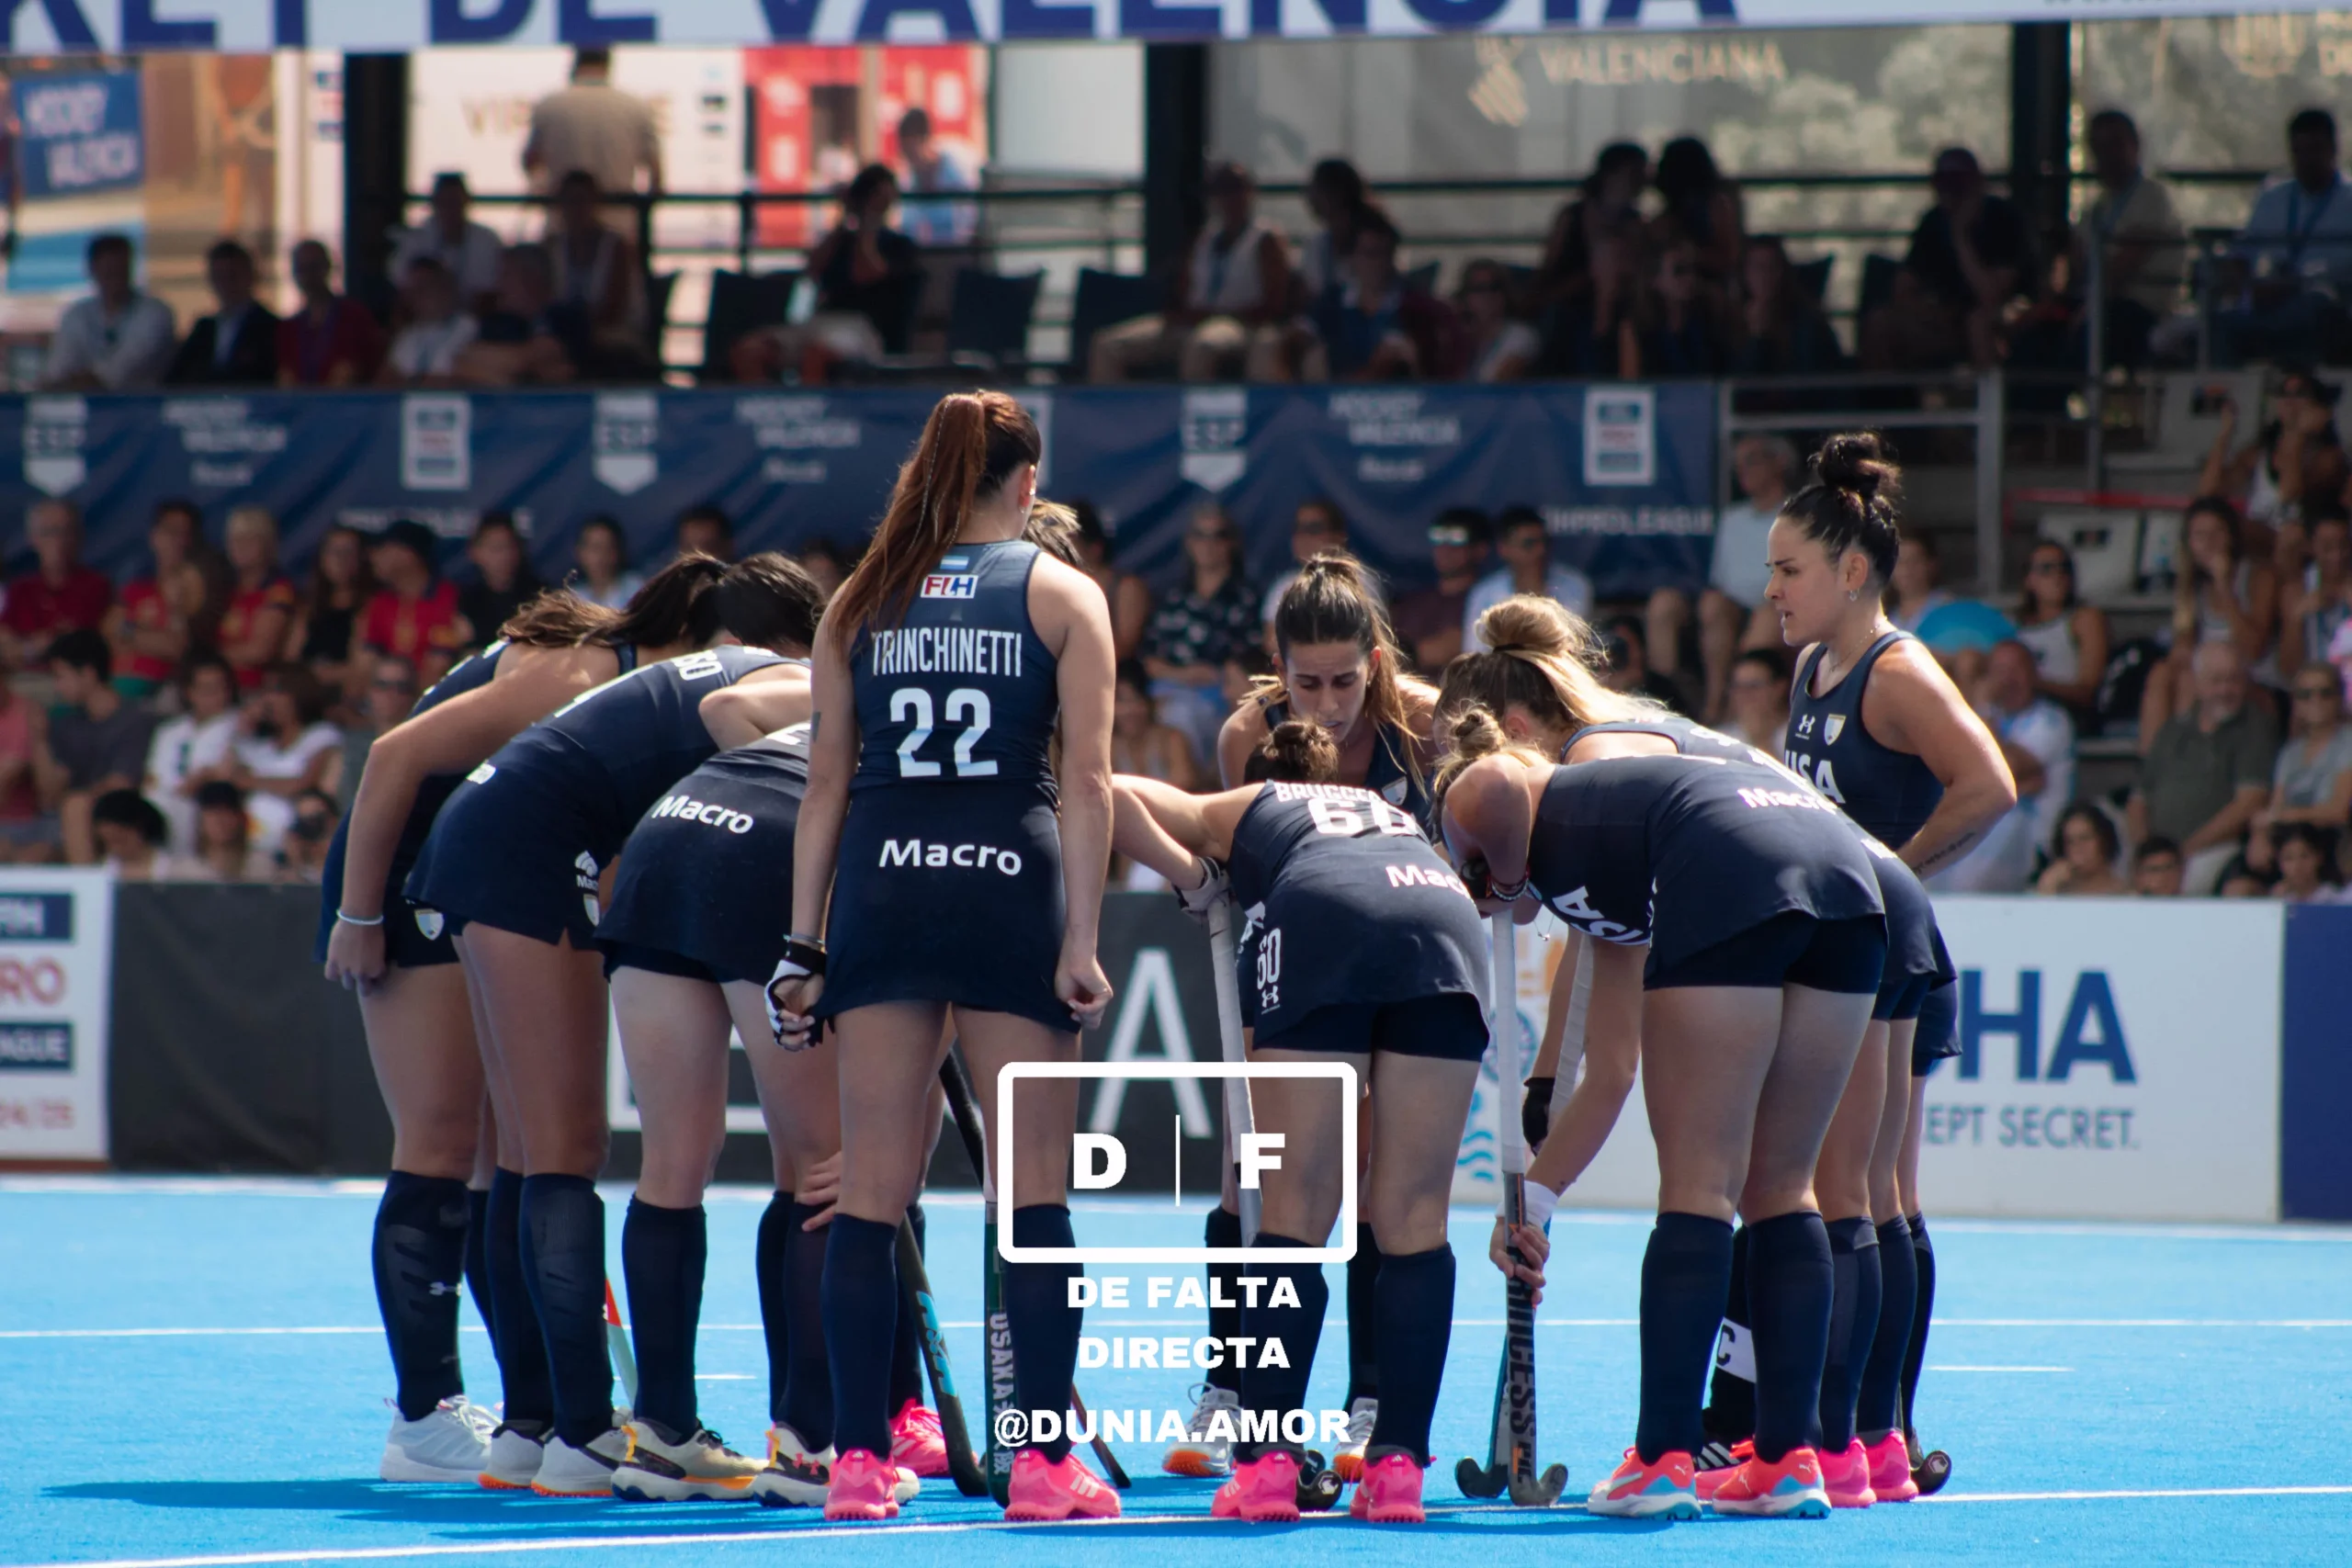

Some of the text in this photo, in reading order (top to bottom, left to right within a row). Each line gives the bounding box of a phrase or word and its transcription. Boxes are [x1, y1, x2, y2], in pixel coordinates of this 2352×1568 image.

[1538, 39, 1786, 85] VALENCIANA
[924, 576, 974, 596] FIH
[872, 627, 1022, 677] TRINCHINETTI
[889, 687, 998, 778] 22
[650, 795, 753, 834] Macro
[878, 839, 1022, 876] Macro
[1929, 969, 2138, 1082] HA
[1922, 1104, 1986, 1145] EPT
